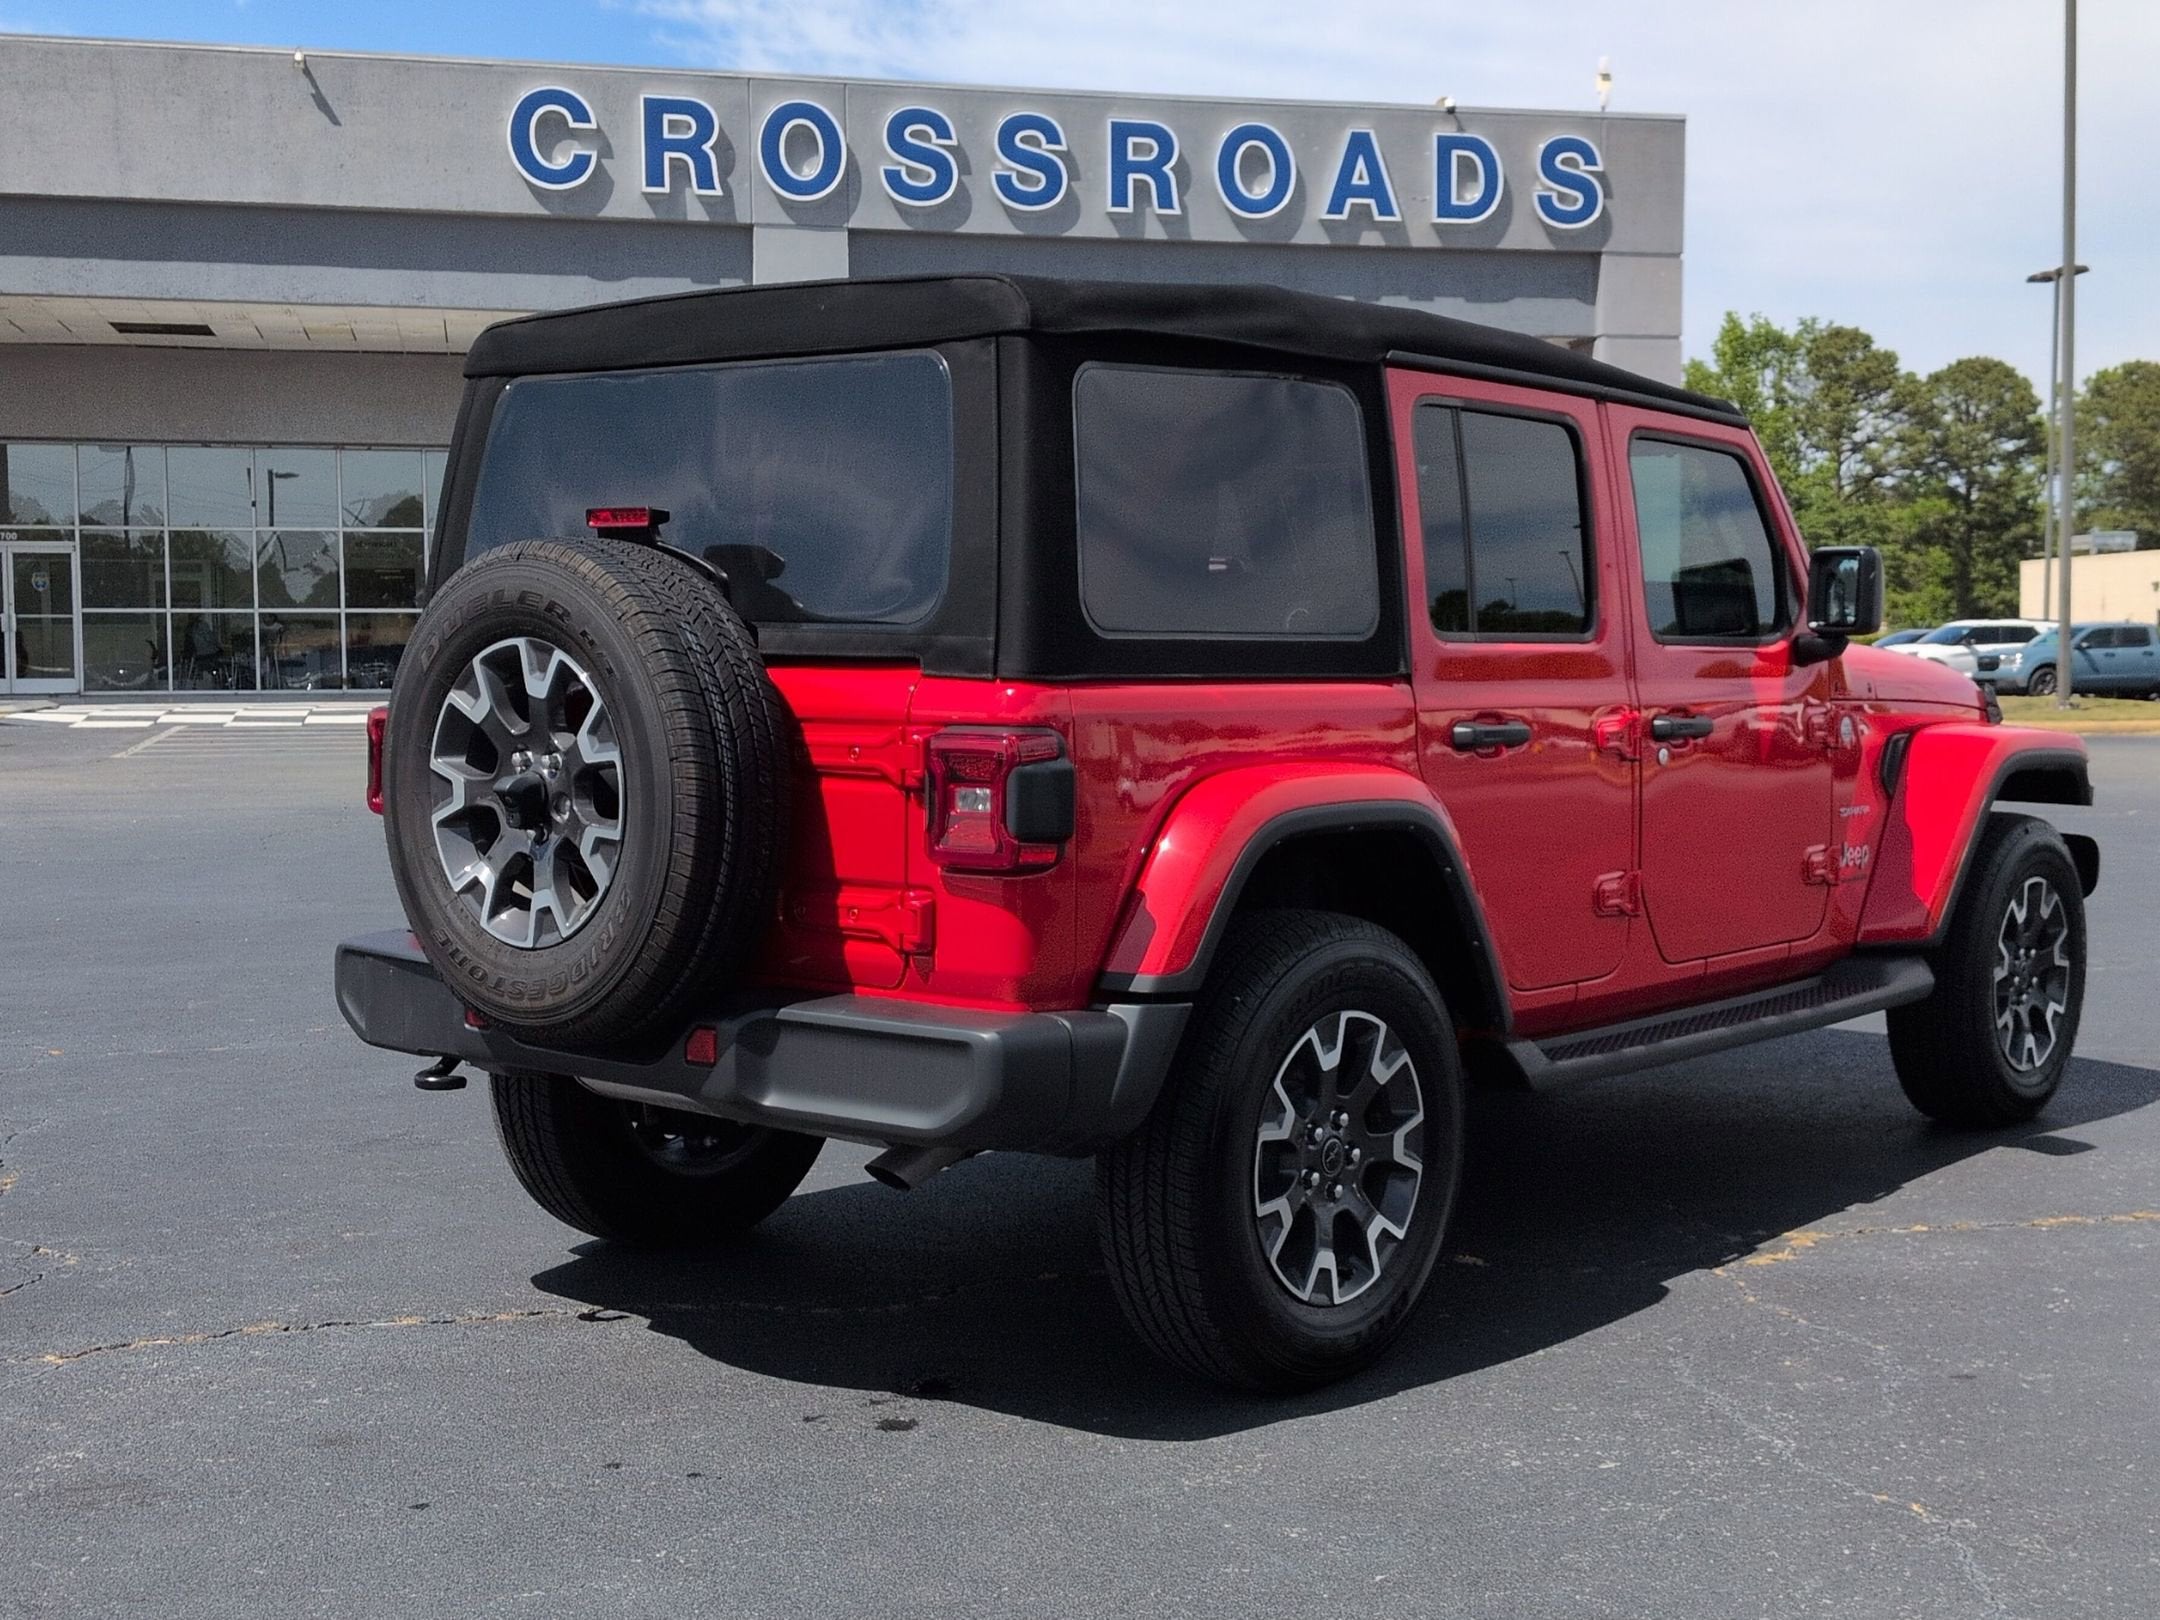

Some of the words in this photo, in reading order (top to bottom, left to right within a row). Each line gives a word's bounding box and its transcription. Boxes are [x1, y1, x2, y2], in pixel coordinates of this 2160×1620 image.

[507, 86, 1604, 229] CROSSROADS
[420, 588, 572, 672] DUELER
[1840, 842, 1869, 869] Jeep
[431, 885, 631, 1001] BRIDGESTONE
